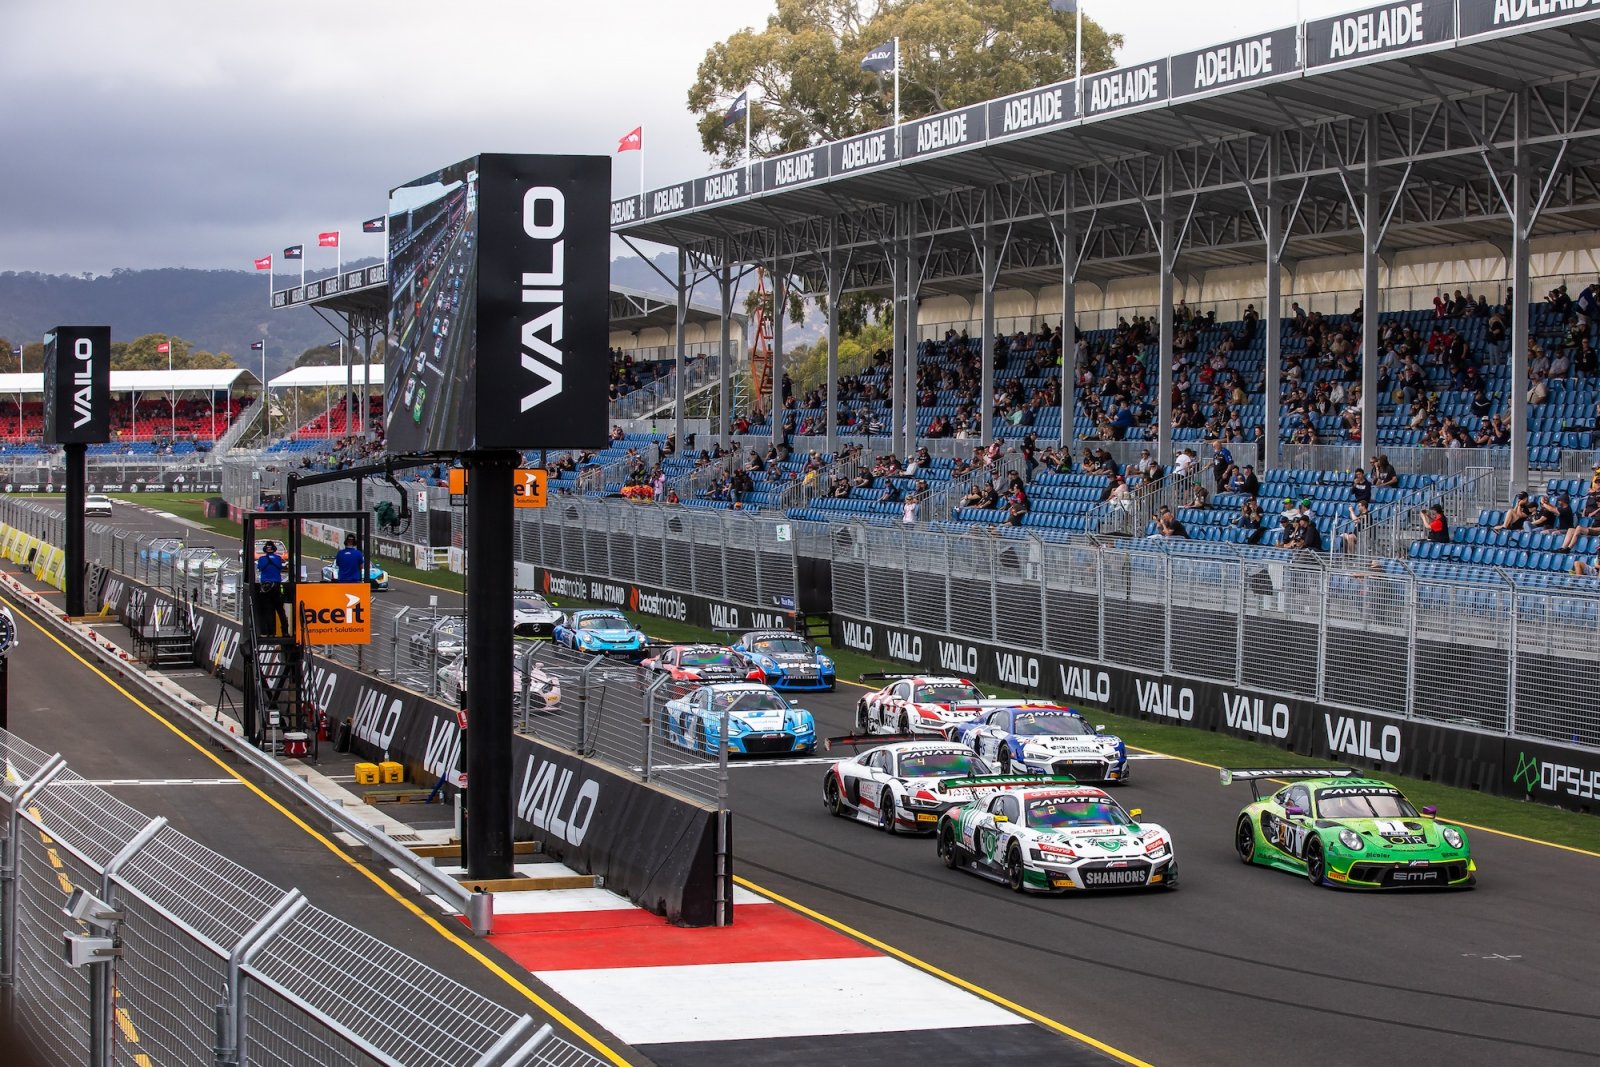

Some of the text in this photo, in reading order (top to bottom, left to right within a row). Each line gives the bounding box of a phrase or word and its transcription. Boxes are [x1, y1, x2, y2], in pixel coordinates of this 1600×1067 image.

[1329, 2, 1423, 59] ADELAIDE
[1194, 37, 1272, 89] ADELAIDE
[1090, 65, 1158, 112] ADELAIDE
[1003, 88, 1062, 132] ADELAIDE
[917, 113, 967, 152] ADELAIDE
[775, 153, 814, 186] ADELAIDE
[842, 134, 886, 170] ADELAIDE
[653, 186, 684, 214] ADELAIDE
[704, 172, 738, 203] ADELAIDE
[520, 186, 565, 414] VAILO
[74, 338, 93, 429] VAILO
[305, 593, 365, 624] aceit
[590, 582, 625, 605] FAN STAND
[709, 603, 739, 629] VAILO
[841, 620, 873, 651] VAILO
[887, 630, 922, 663] VAILO
[938, 640, 978, 675] VAILO
[995, 651, 1040, 688] VAILO
[1059, 664, 1110, 703] VAILO
[1135, 678, 1194, 721] VAILO
[351, 685, 402, 750] VAILO
[1222, 692, 1290, 739] VAILO
[423, 715, 462, 789] VAIL
[901, 750, 973, 760] FANATEC
[1324, 713, 1401, 763] VAILO
[917, 758, 925, 766] 4
[518, 754, 600, 847] VAILO
[1030, 797, 1112, 809] FANATEC
[1320, 788, 1399, 796] FANATEC
[1047, 805, 1057, 815] 2
[1390, 835, 1425, 844] OTR
[1086, 870, 1146, 885] SHANNONS
[1393, 871, 1438, 881] EMA
